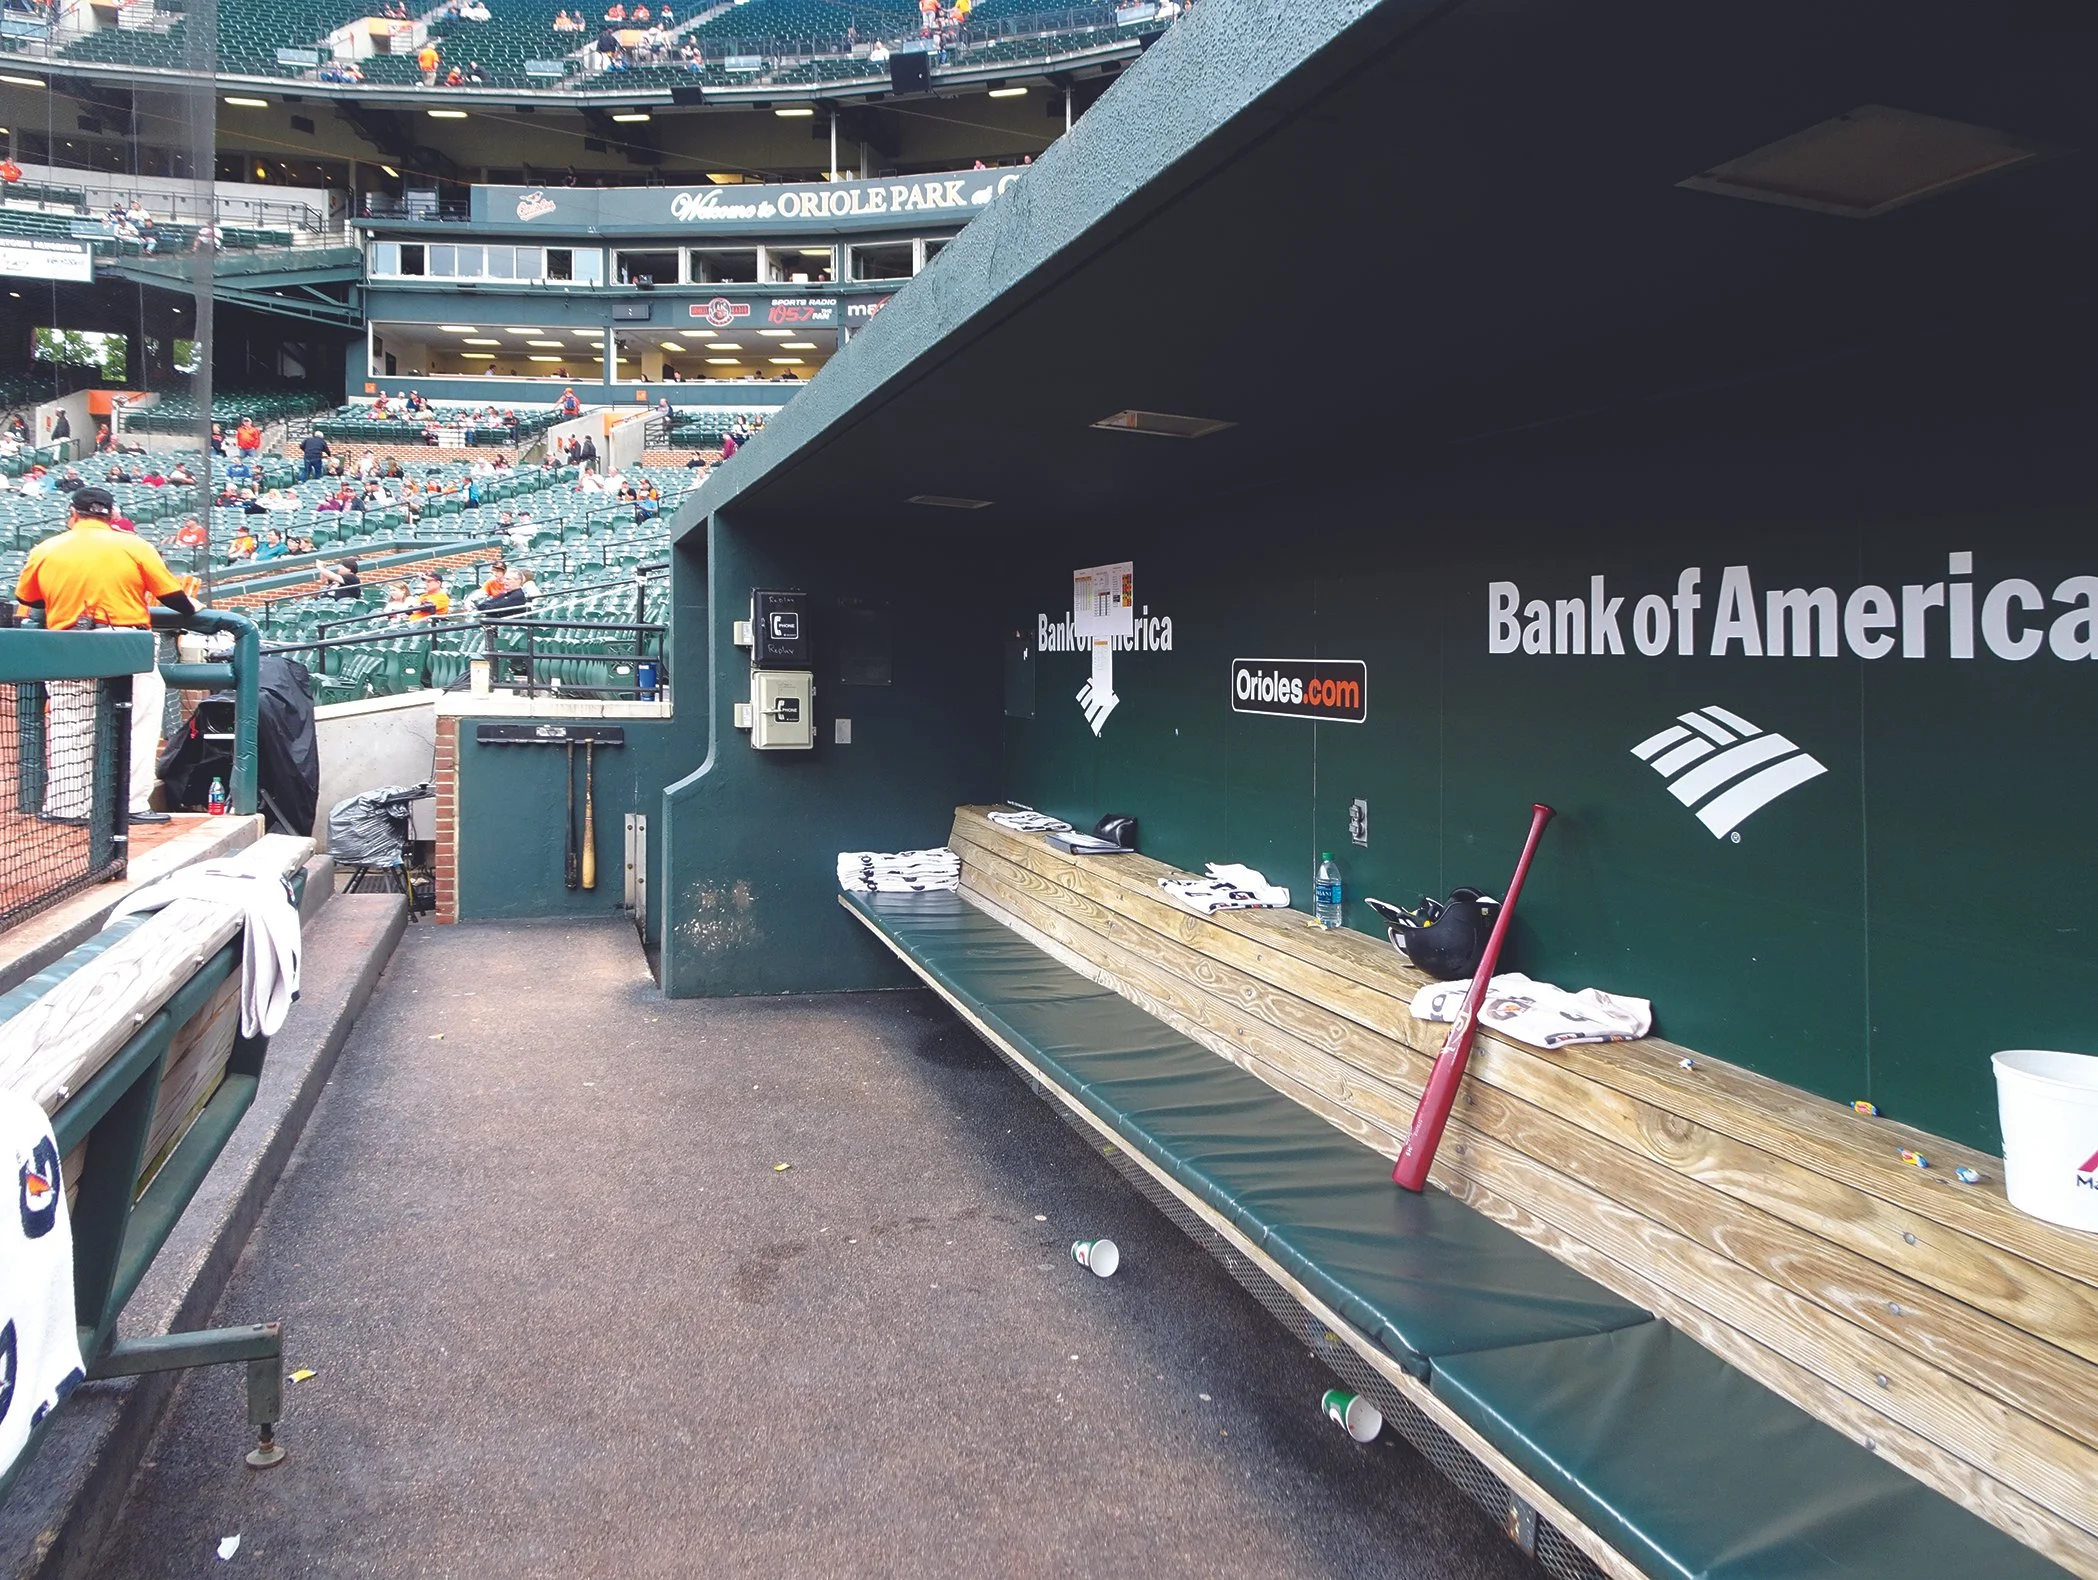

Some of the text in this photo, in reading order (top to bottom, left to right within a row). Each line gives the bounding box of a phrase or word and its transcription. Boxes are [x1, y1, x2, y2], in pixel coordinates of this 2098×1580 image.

[671, 189, 756, 221] Welcome
[757, 200, 777, 218] to
[777, 187, 888, 218] ORIOLE
[890, 180, 967, 212] PARK
[970, 185, 993, 205] at
[768, 304, 815, 324] 105.7
[812, 312, 830, 320] FAN
[768, 595, 795, 604] Replay
[1489, 551, 2098, 661] Bank of America
[1038, 611, 1075, 652] Bank
[767, 643, 796, 655] Replay
[1236, 668, 1359, 708] Orioles.com
